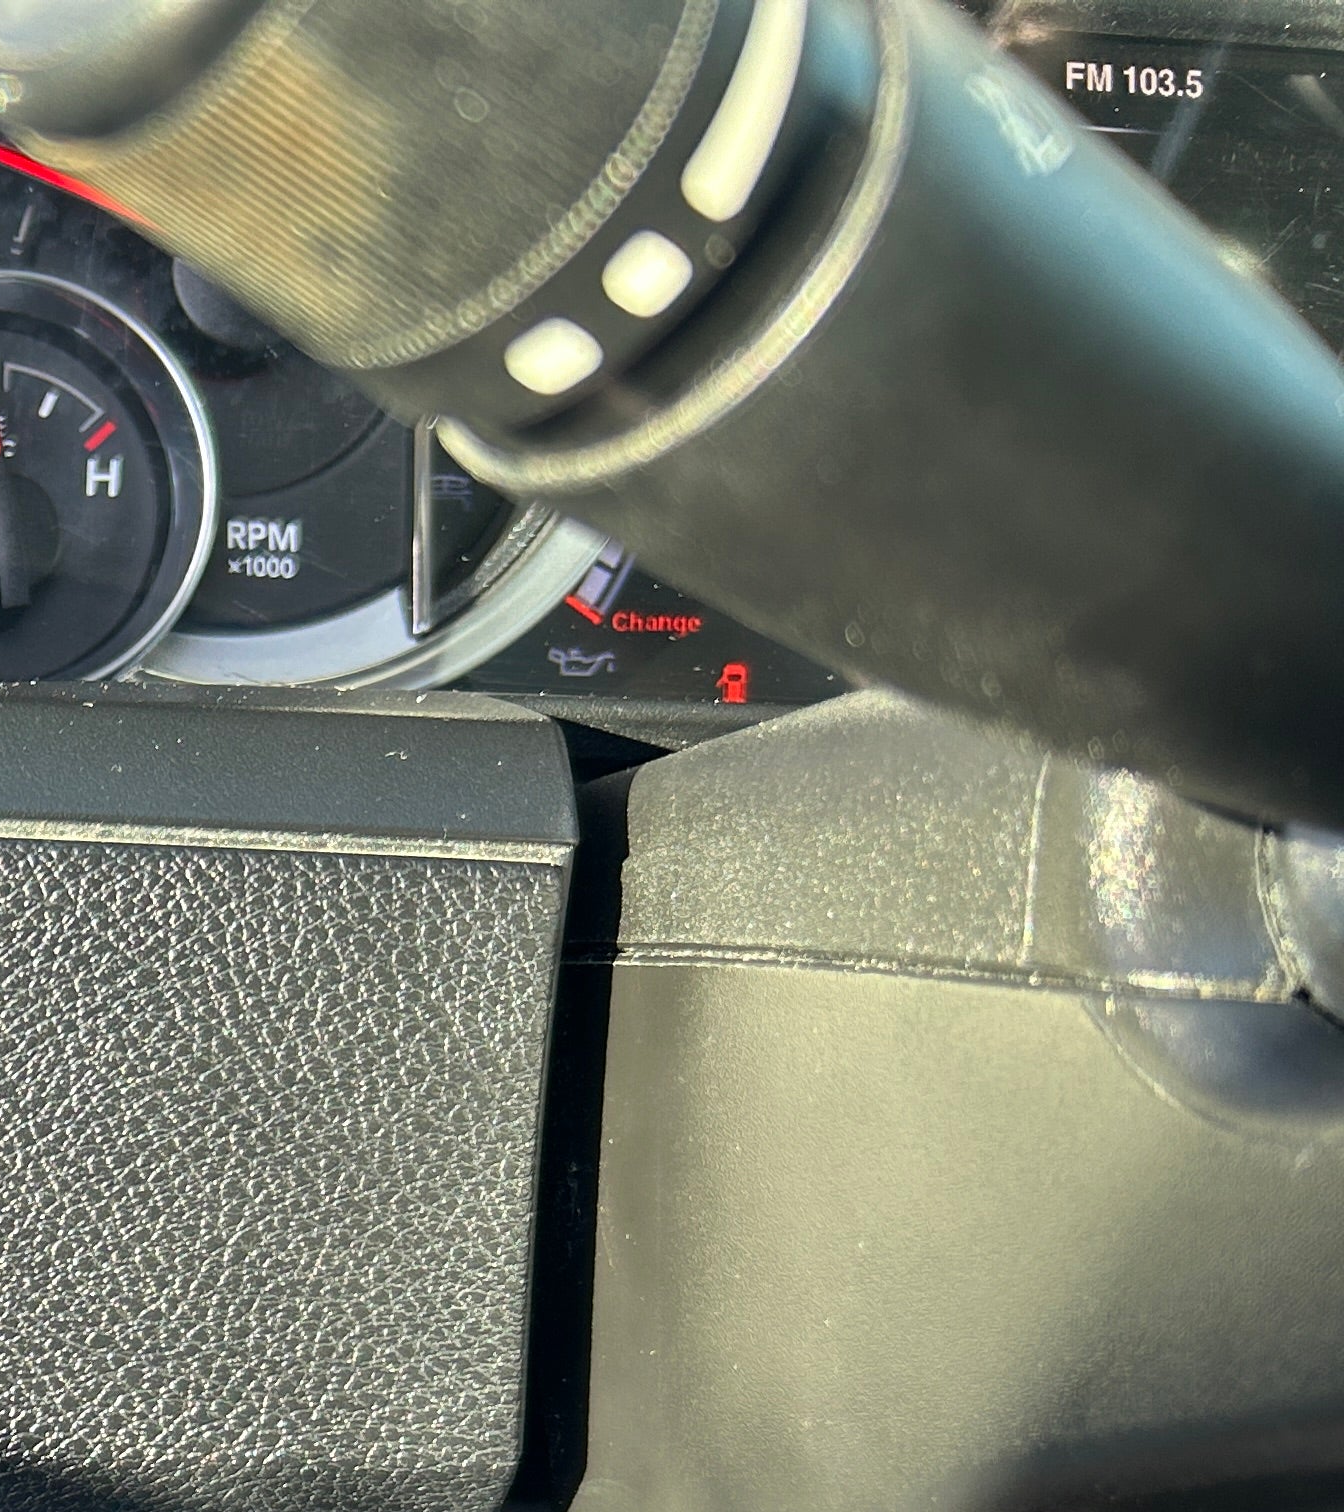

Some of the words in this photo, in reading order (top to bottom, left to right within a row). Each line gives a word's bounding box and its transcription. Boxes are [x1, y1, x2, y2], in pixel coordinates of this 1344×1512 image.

[1066, 61, 1112, 92] FM
[1123, 65, 1203, 98] 103.5
[85, 455, 122, 498] H
[227, 519, 300, 553] RPM
[611, 610, 703, 638] Change
